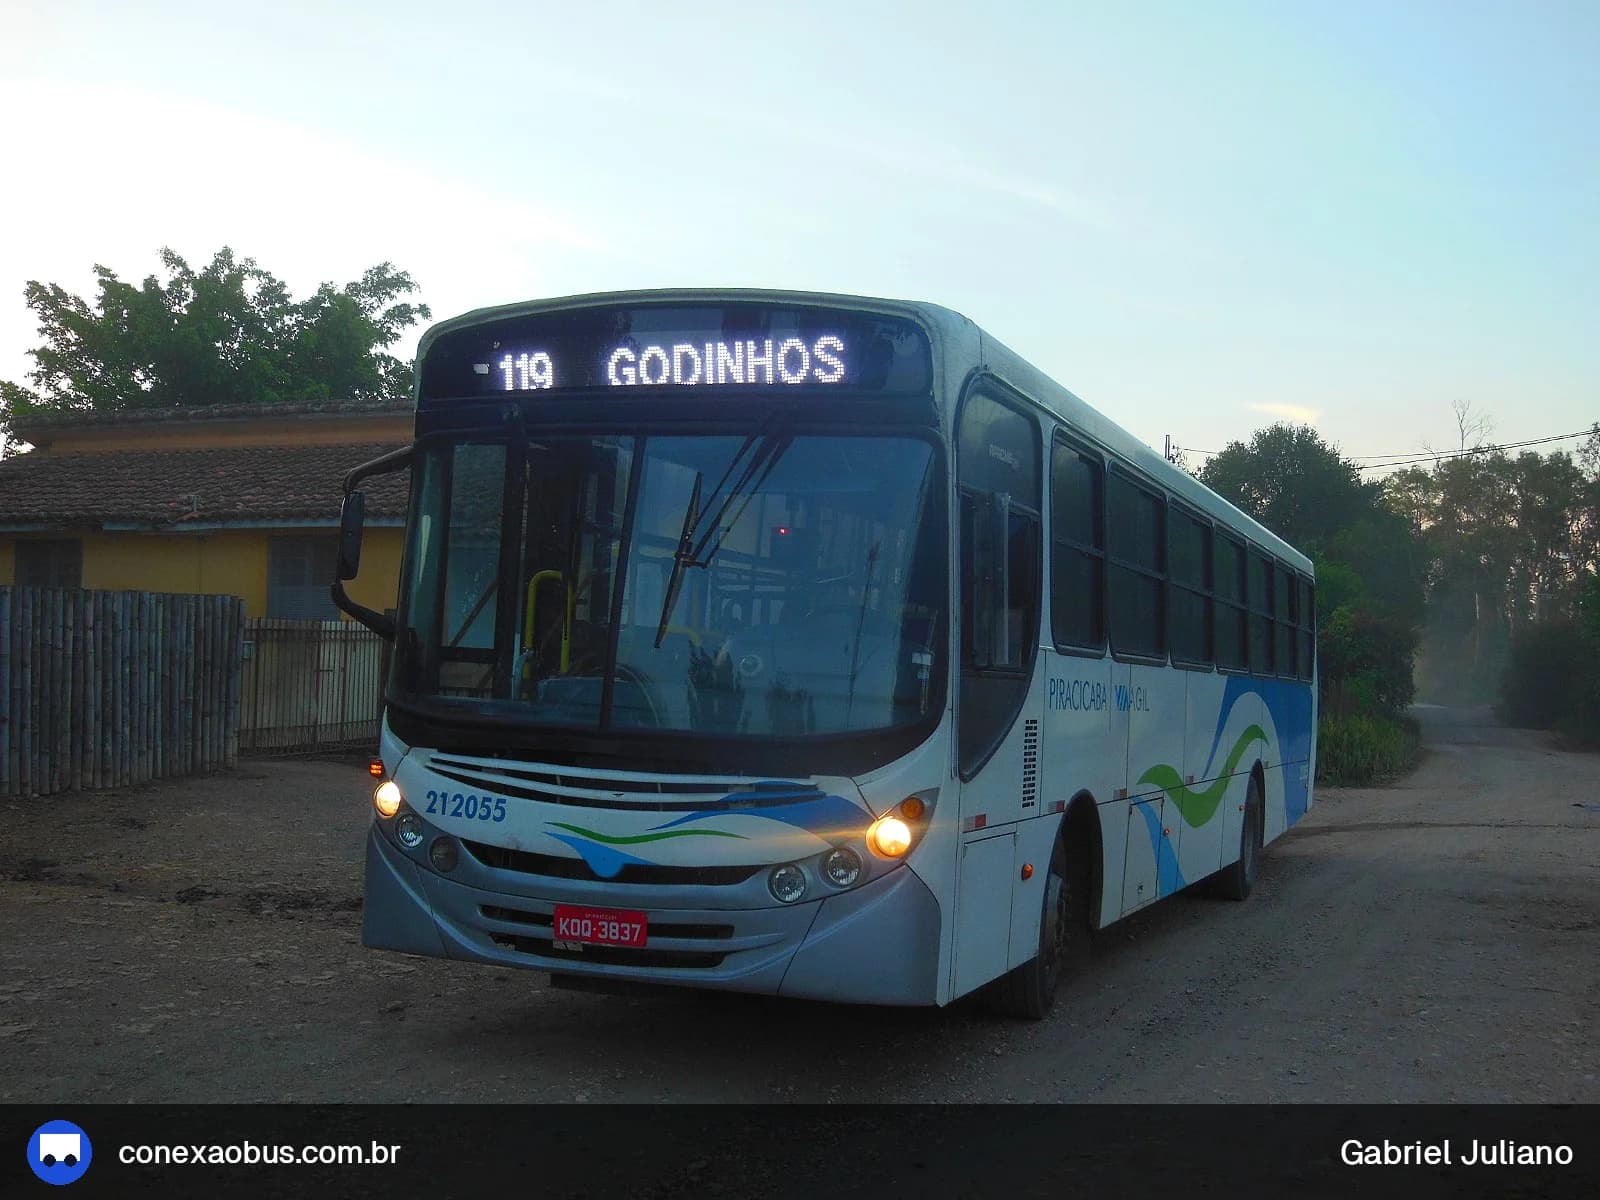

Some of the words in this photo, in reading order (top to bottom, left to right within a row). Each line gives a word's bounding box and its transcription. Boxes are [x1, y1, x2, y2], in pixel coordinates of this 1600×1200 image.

[499, 351, 553, 390] 119
[607, 336, 845, 386] GODINHOS
[1049, 678, 1107, 712] PIRACICABA
[426, 790, 507, 822] 212055
